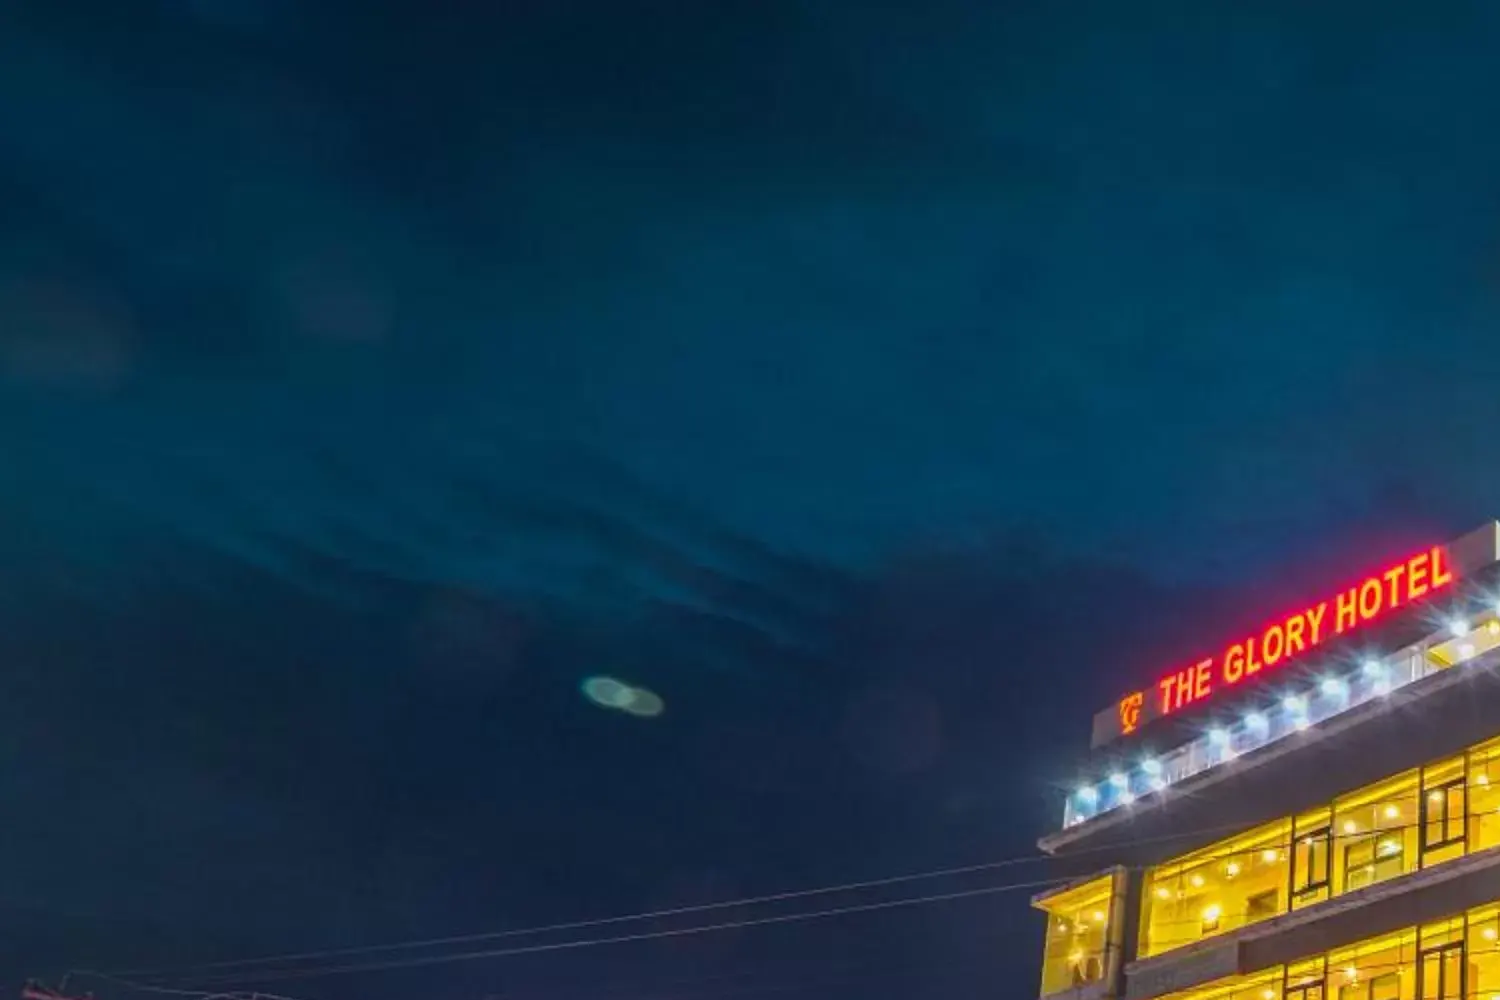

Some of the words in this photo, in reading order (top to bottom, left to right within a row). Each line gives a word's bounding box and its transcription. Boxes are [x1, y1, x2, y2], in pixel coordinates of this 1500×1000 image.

[1158, 658, 1213, 714] THE
[1222, 601, 1327, 684] GLORY
[1335, 545, 1453, 634] HOTEL
